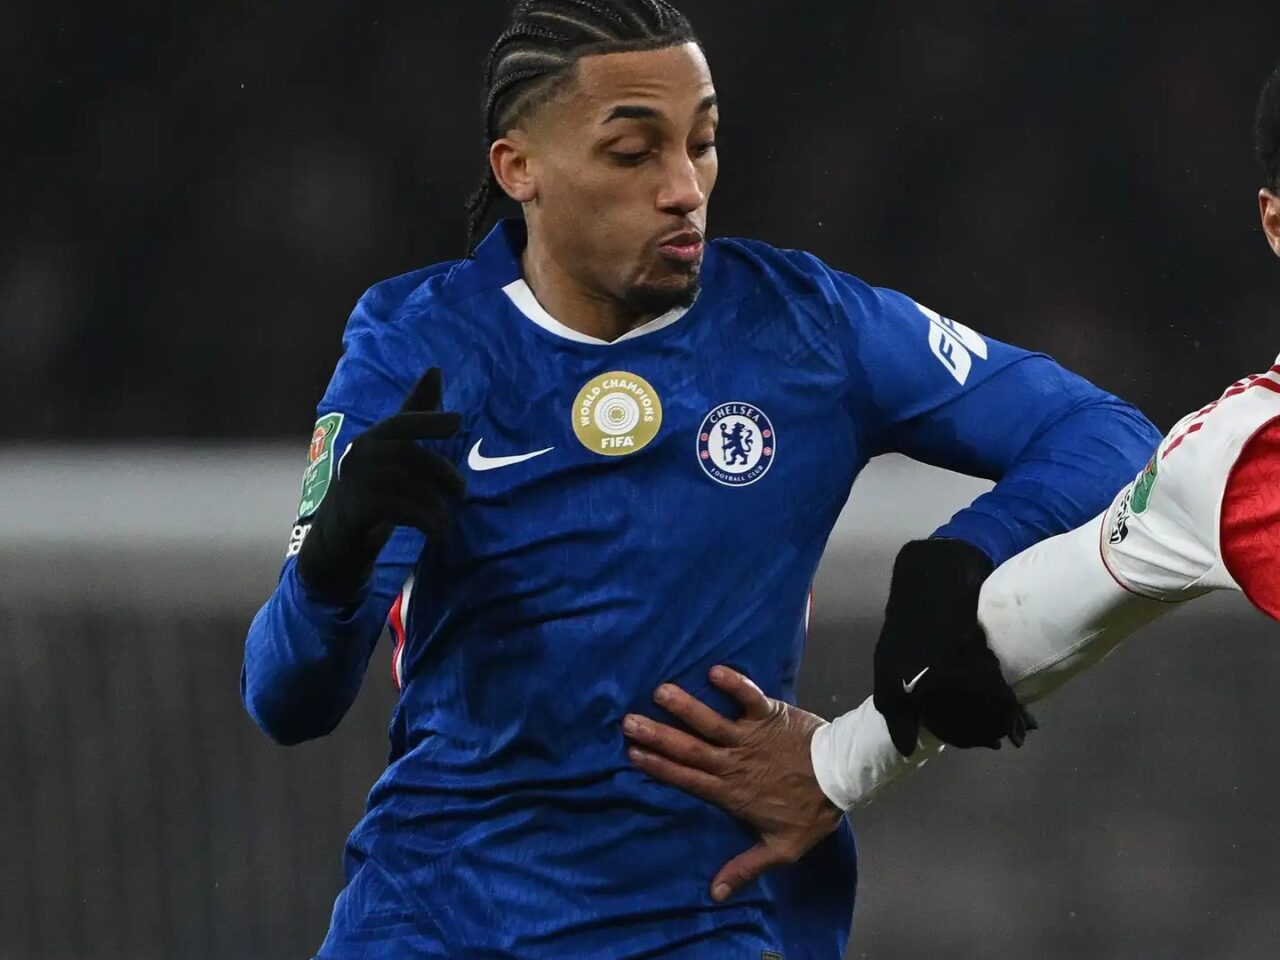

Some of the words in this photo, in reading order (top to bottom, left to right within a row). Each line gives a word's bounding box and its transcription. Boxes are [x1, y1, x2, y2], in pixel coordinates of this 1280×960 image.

[580, 386, 601, 427] WORLD
[602, 379, 654, 422] CHAMPIONS
[710, 405, 761, 424] CHELSEA
[601, 435, 634, 449] FIFA
[710, 467, 746, 483] FOOTBALL
[747, 465, 764, 480] CLUB
